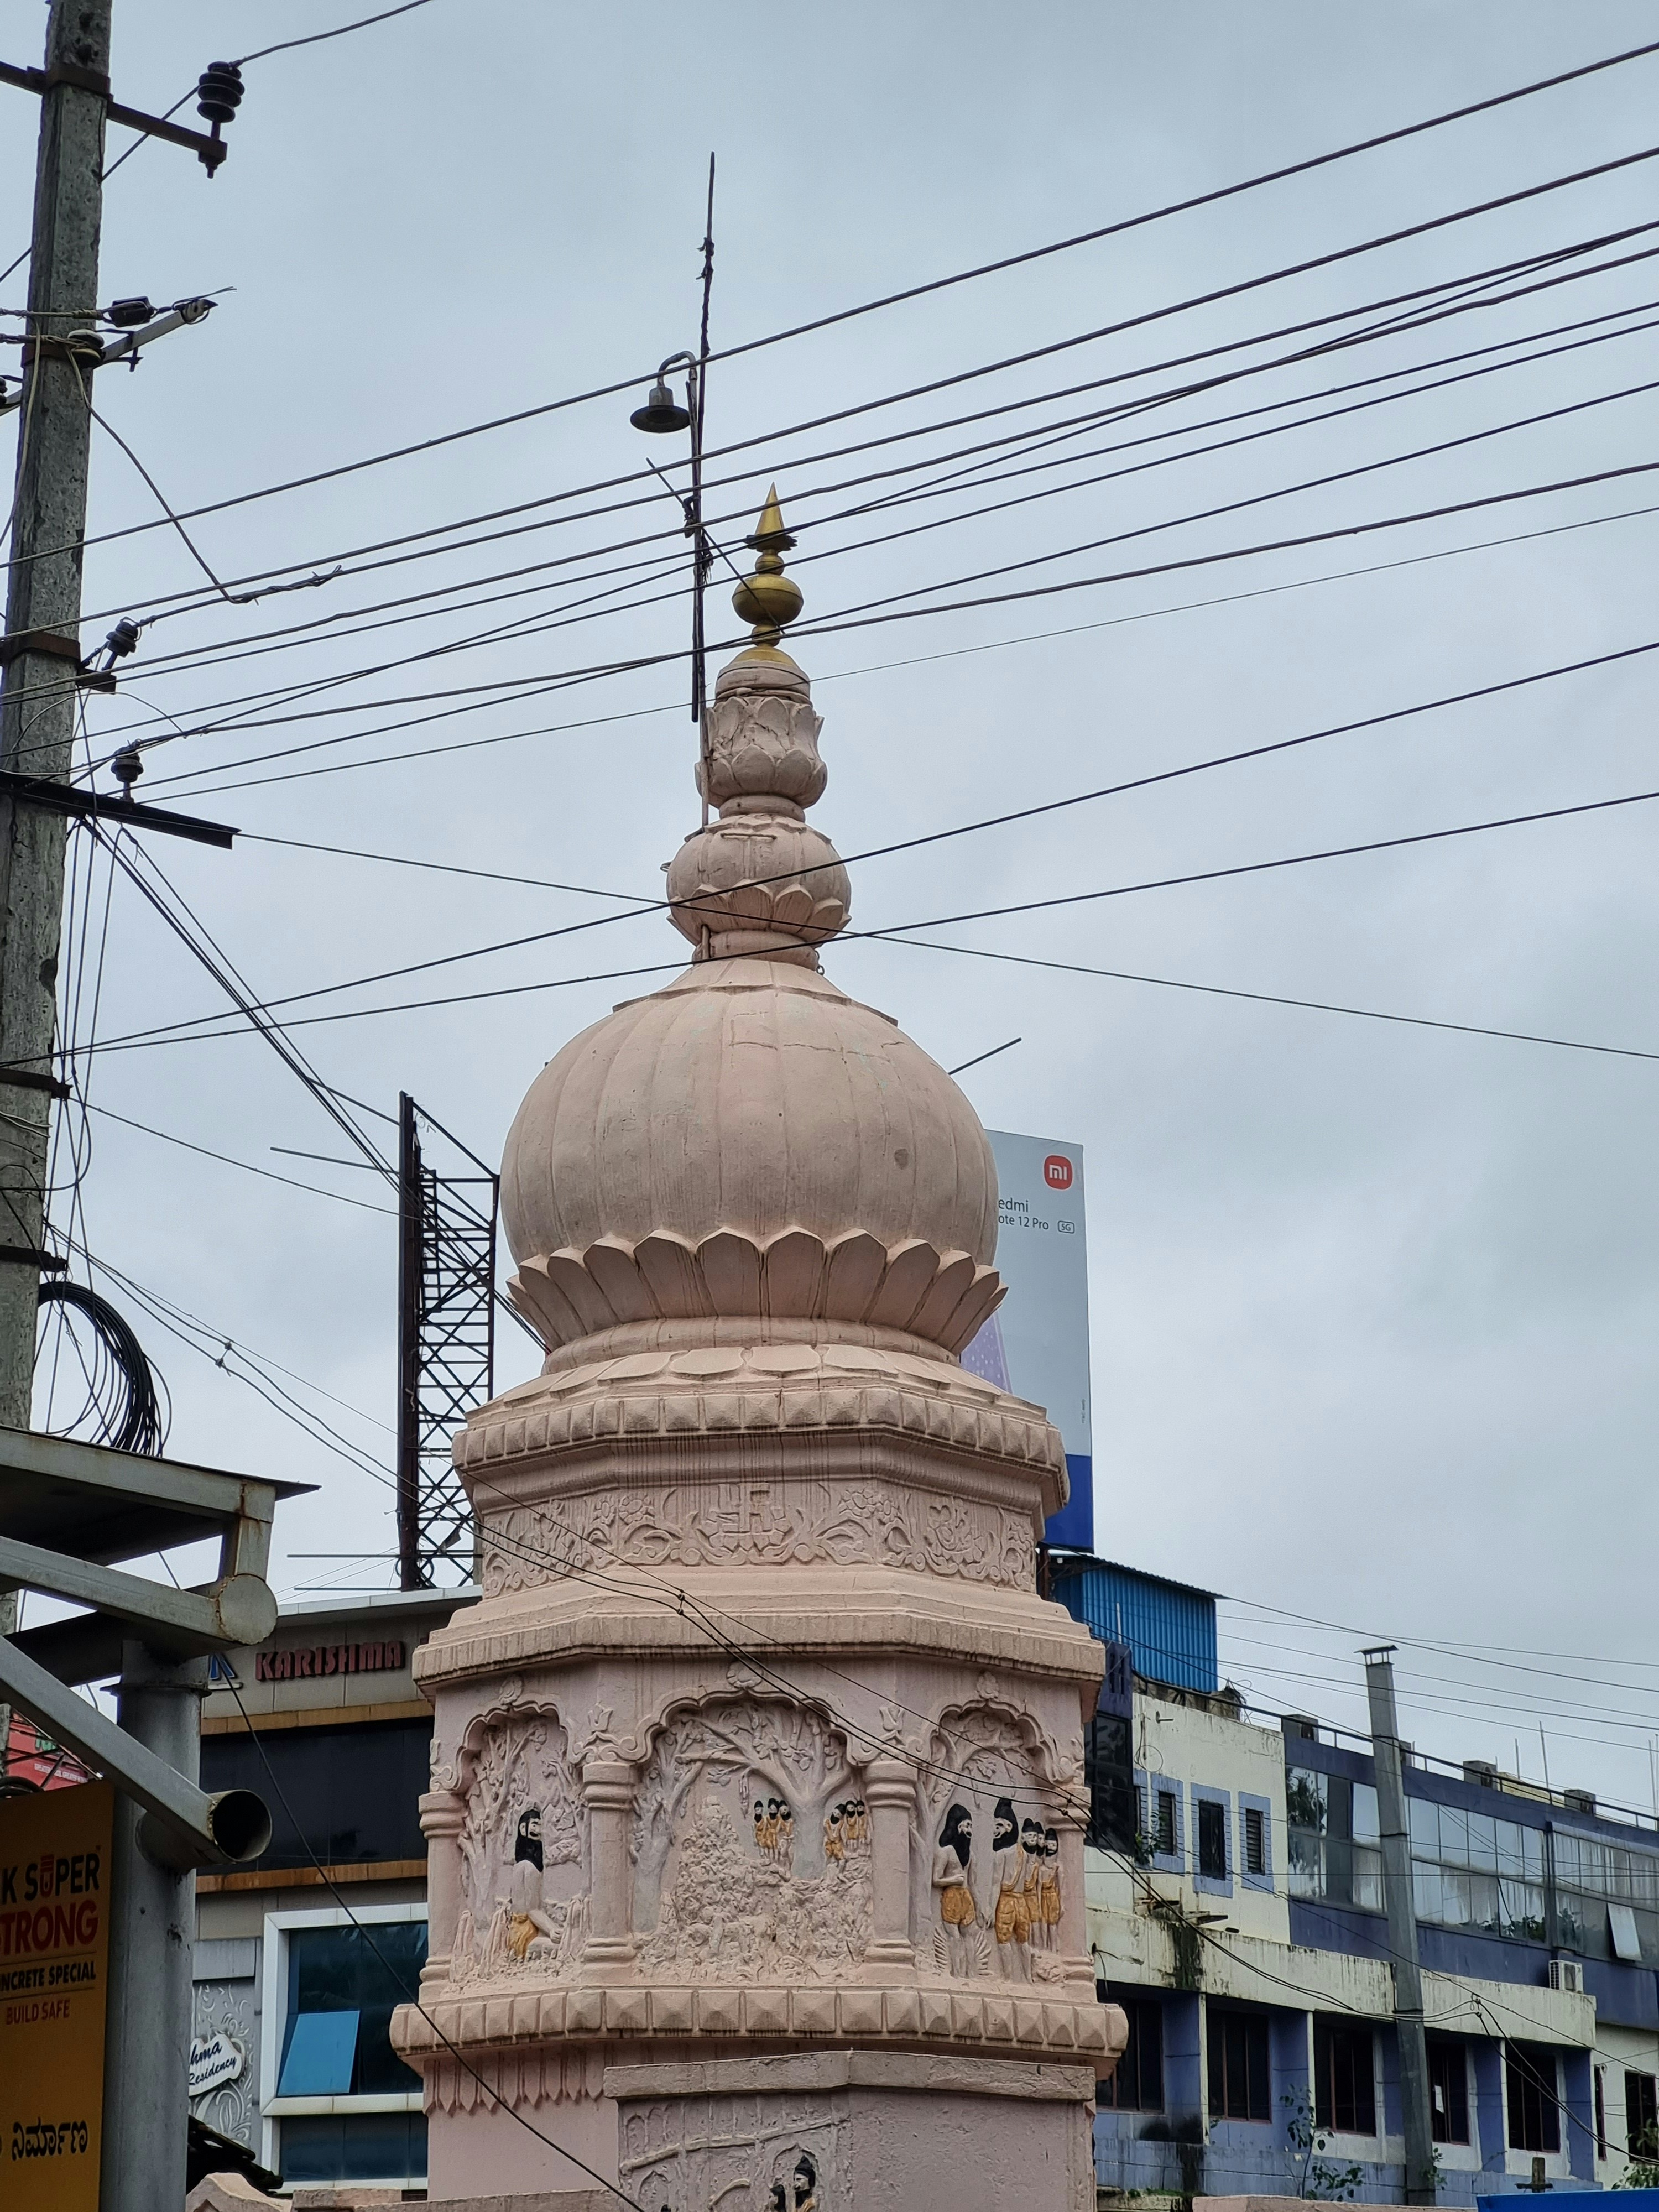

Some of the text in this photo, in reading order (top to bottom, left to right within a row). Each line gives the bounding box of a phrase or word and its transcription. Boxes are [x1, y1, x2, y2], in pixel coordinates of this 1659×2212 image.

[998, 1197, 1029, 1213] edmi
[998, 1214, 1072, 1232] ote 12 Pro 5G
[255, 1641, 405, 1681] KARISHMA
[24, 1853, 100, 1901] SUPER
[48, 1961, 97, 1986] SPECIAL
[6, 1999, 71, 2025] BUILD SAFE
[12, 2116, 88, 2162] ನಿರ್ಮಾಣ
